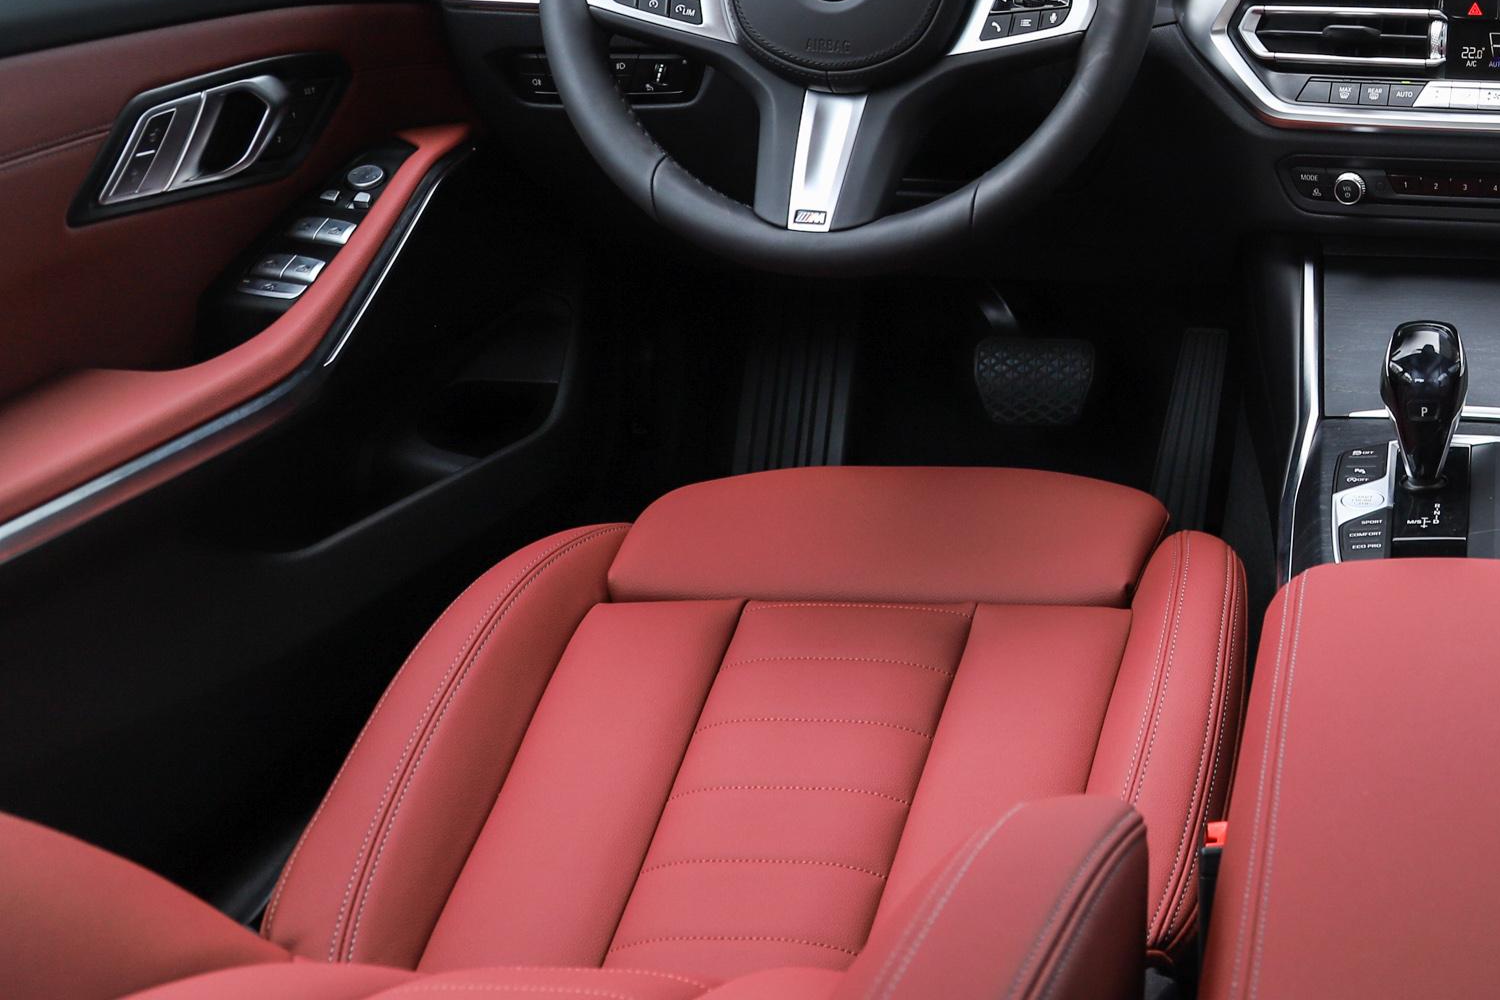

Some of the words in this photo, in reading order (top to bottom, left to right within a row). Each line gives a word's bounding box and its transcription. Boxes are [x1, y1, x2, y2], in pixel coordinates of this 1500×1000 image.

[682, 7, 696, 17] LIM
[1465, 60, 1478, 68] A/C
[1300, 173, 1319, 182] MODE
[1403, 181, 1408, 189] 1
[1493, 184, 1498, 192] 4
[1420, 406, 1428, 418] P
